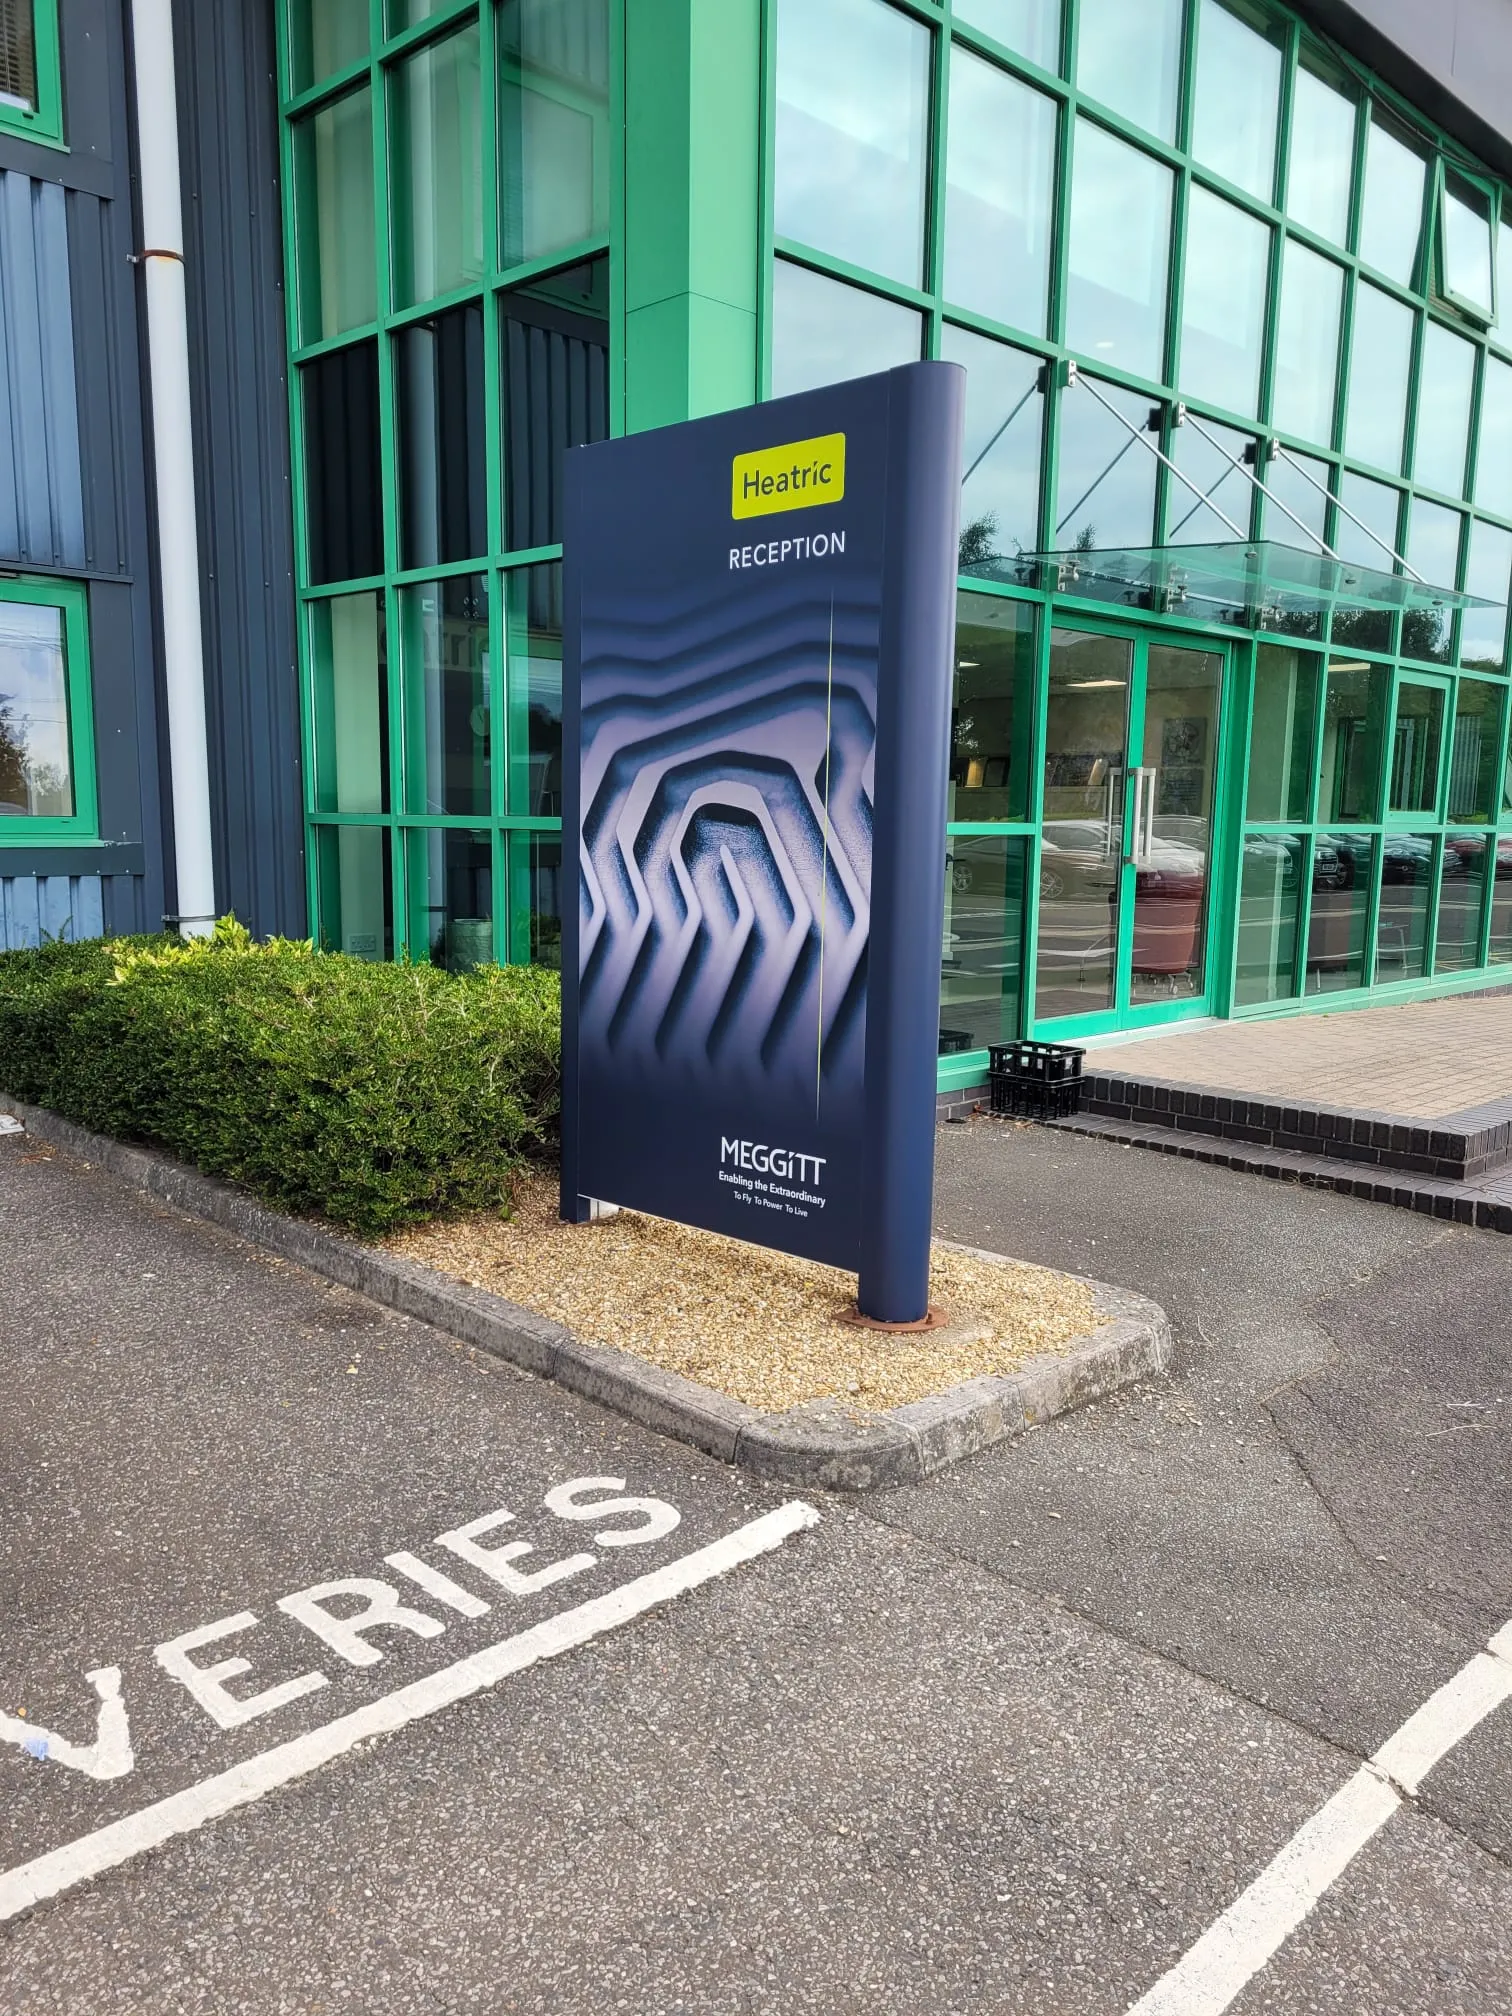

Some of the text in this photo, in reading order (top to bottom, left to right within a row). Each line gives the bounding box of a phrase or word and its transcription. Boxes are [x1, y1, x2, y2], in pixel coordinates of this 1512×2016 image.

[743, 461, 832, 500] Heatric
[729, 531, 846, 570] RECEPTION
[721, 1136, 827, 1185] MEGGITT
[718, 1170, 826, 1208] Enabling the Extraordinary
[733, 1191, 808, 1217] To Fly To Power To Live
